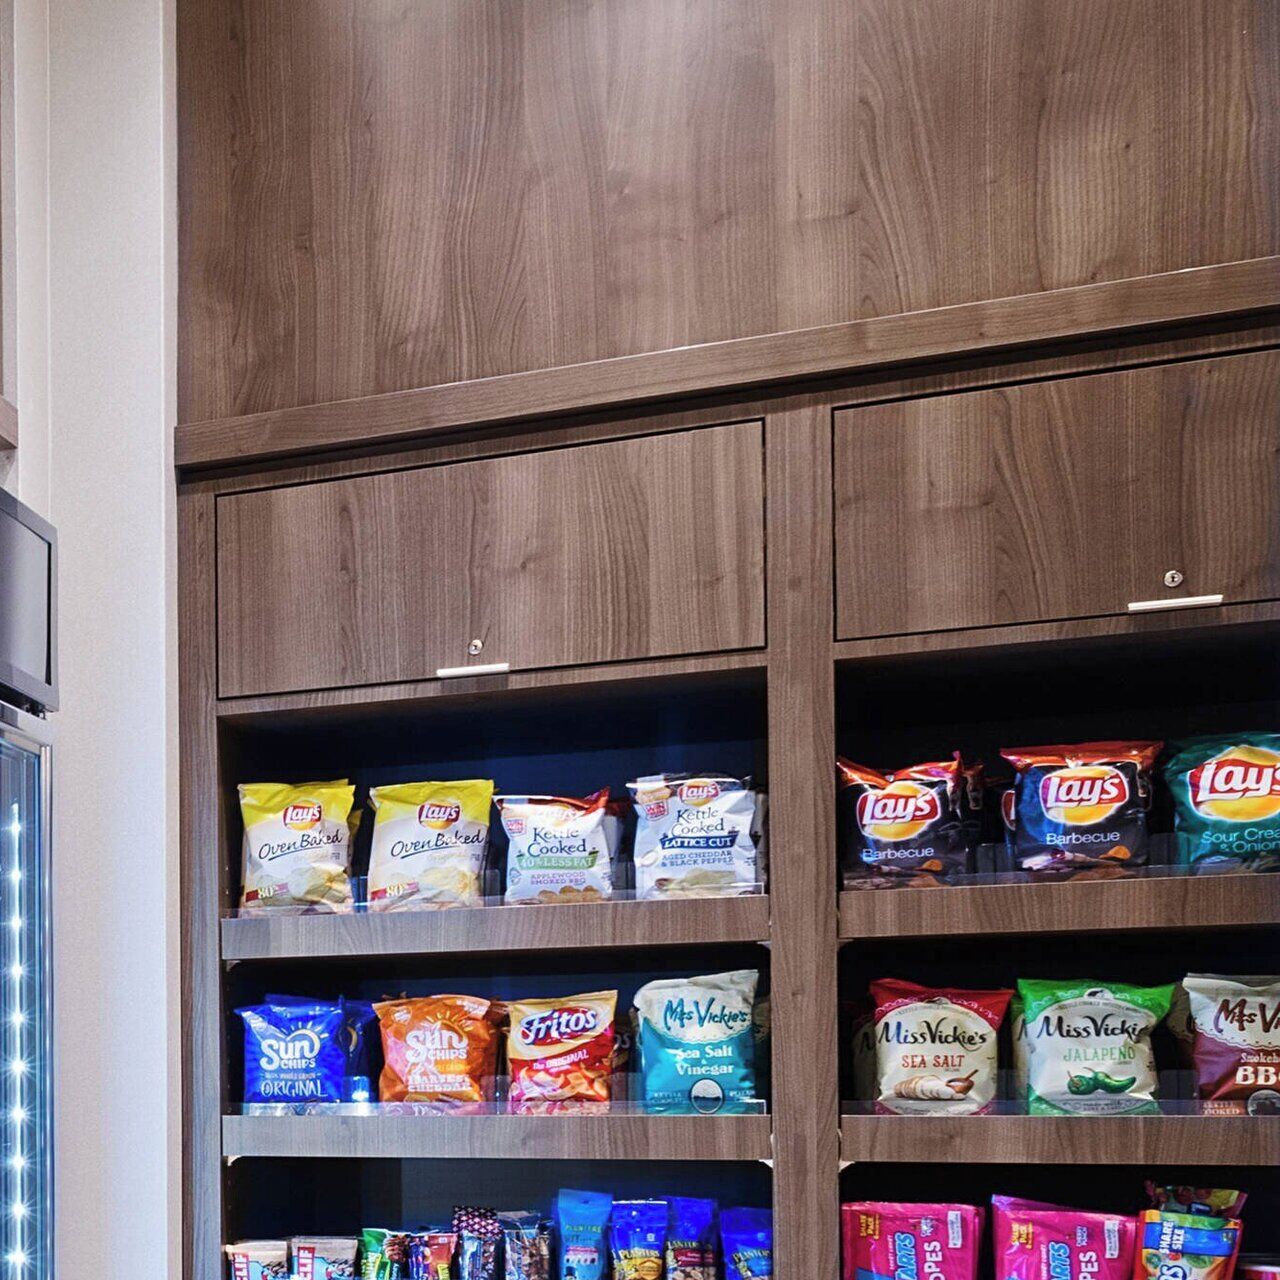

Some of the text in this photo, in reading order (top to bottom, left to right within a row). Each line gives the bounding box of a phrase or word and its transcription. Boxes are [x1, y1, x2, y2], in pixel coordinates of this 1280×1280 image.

[1049, 774, 1119, 807] Lay's
[286, 805, 322, 822] Lay's
[421, 803, 460, 821] Lay's
[676, 807, 718, 822] Kettle
[862, 796, 931, 826] Lay's
[671, 820, 725, 837] Cooked
[1202, 829, 1241, 844] Sour
[663, 836, 732, 849] LATTICE CUT
[1046, 829, 1120, 846] Barbecue
[528, 839, 587, 857] Cooked
[863, 847, 934, 860] Barbecue
[522, 1008, 598, 1045] Fritos
[878, 1017, 988, 1052] Miss Vickie's
[676, 1045, 733, 1059] Sea Salt
[281, 1058, 316, 1069] CHIPS
[676, 1063, 734, 1076] Vinegar
[902, 1054, 965, 1069] SEA SALT
[261, 1080, 328, 1097] ORIGINAL
